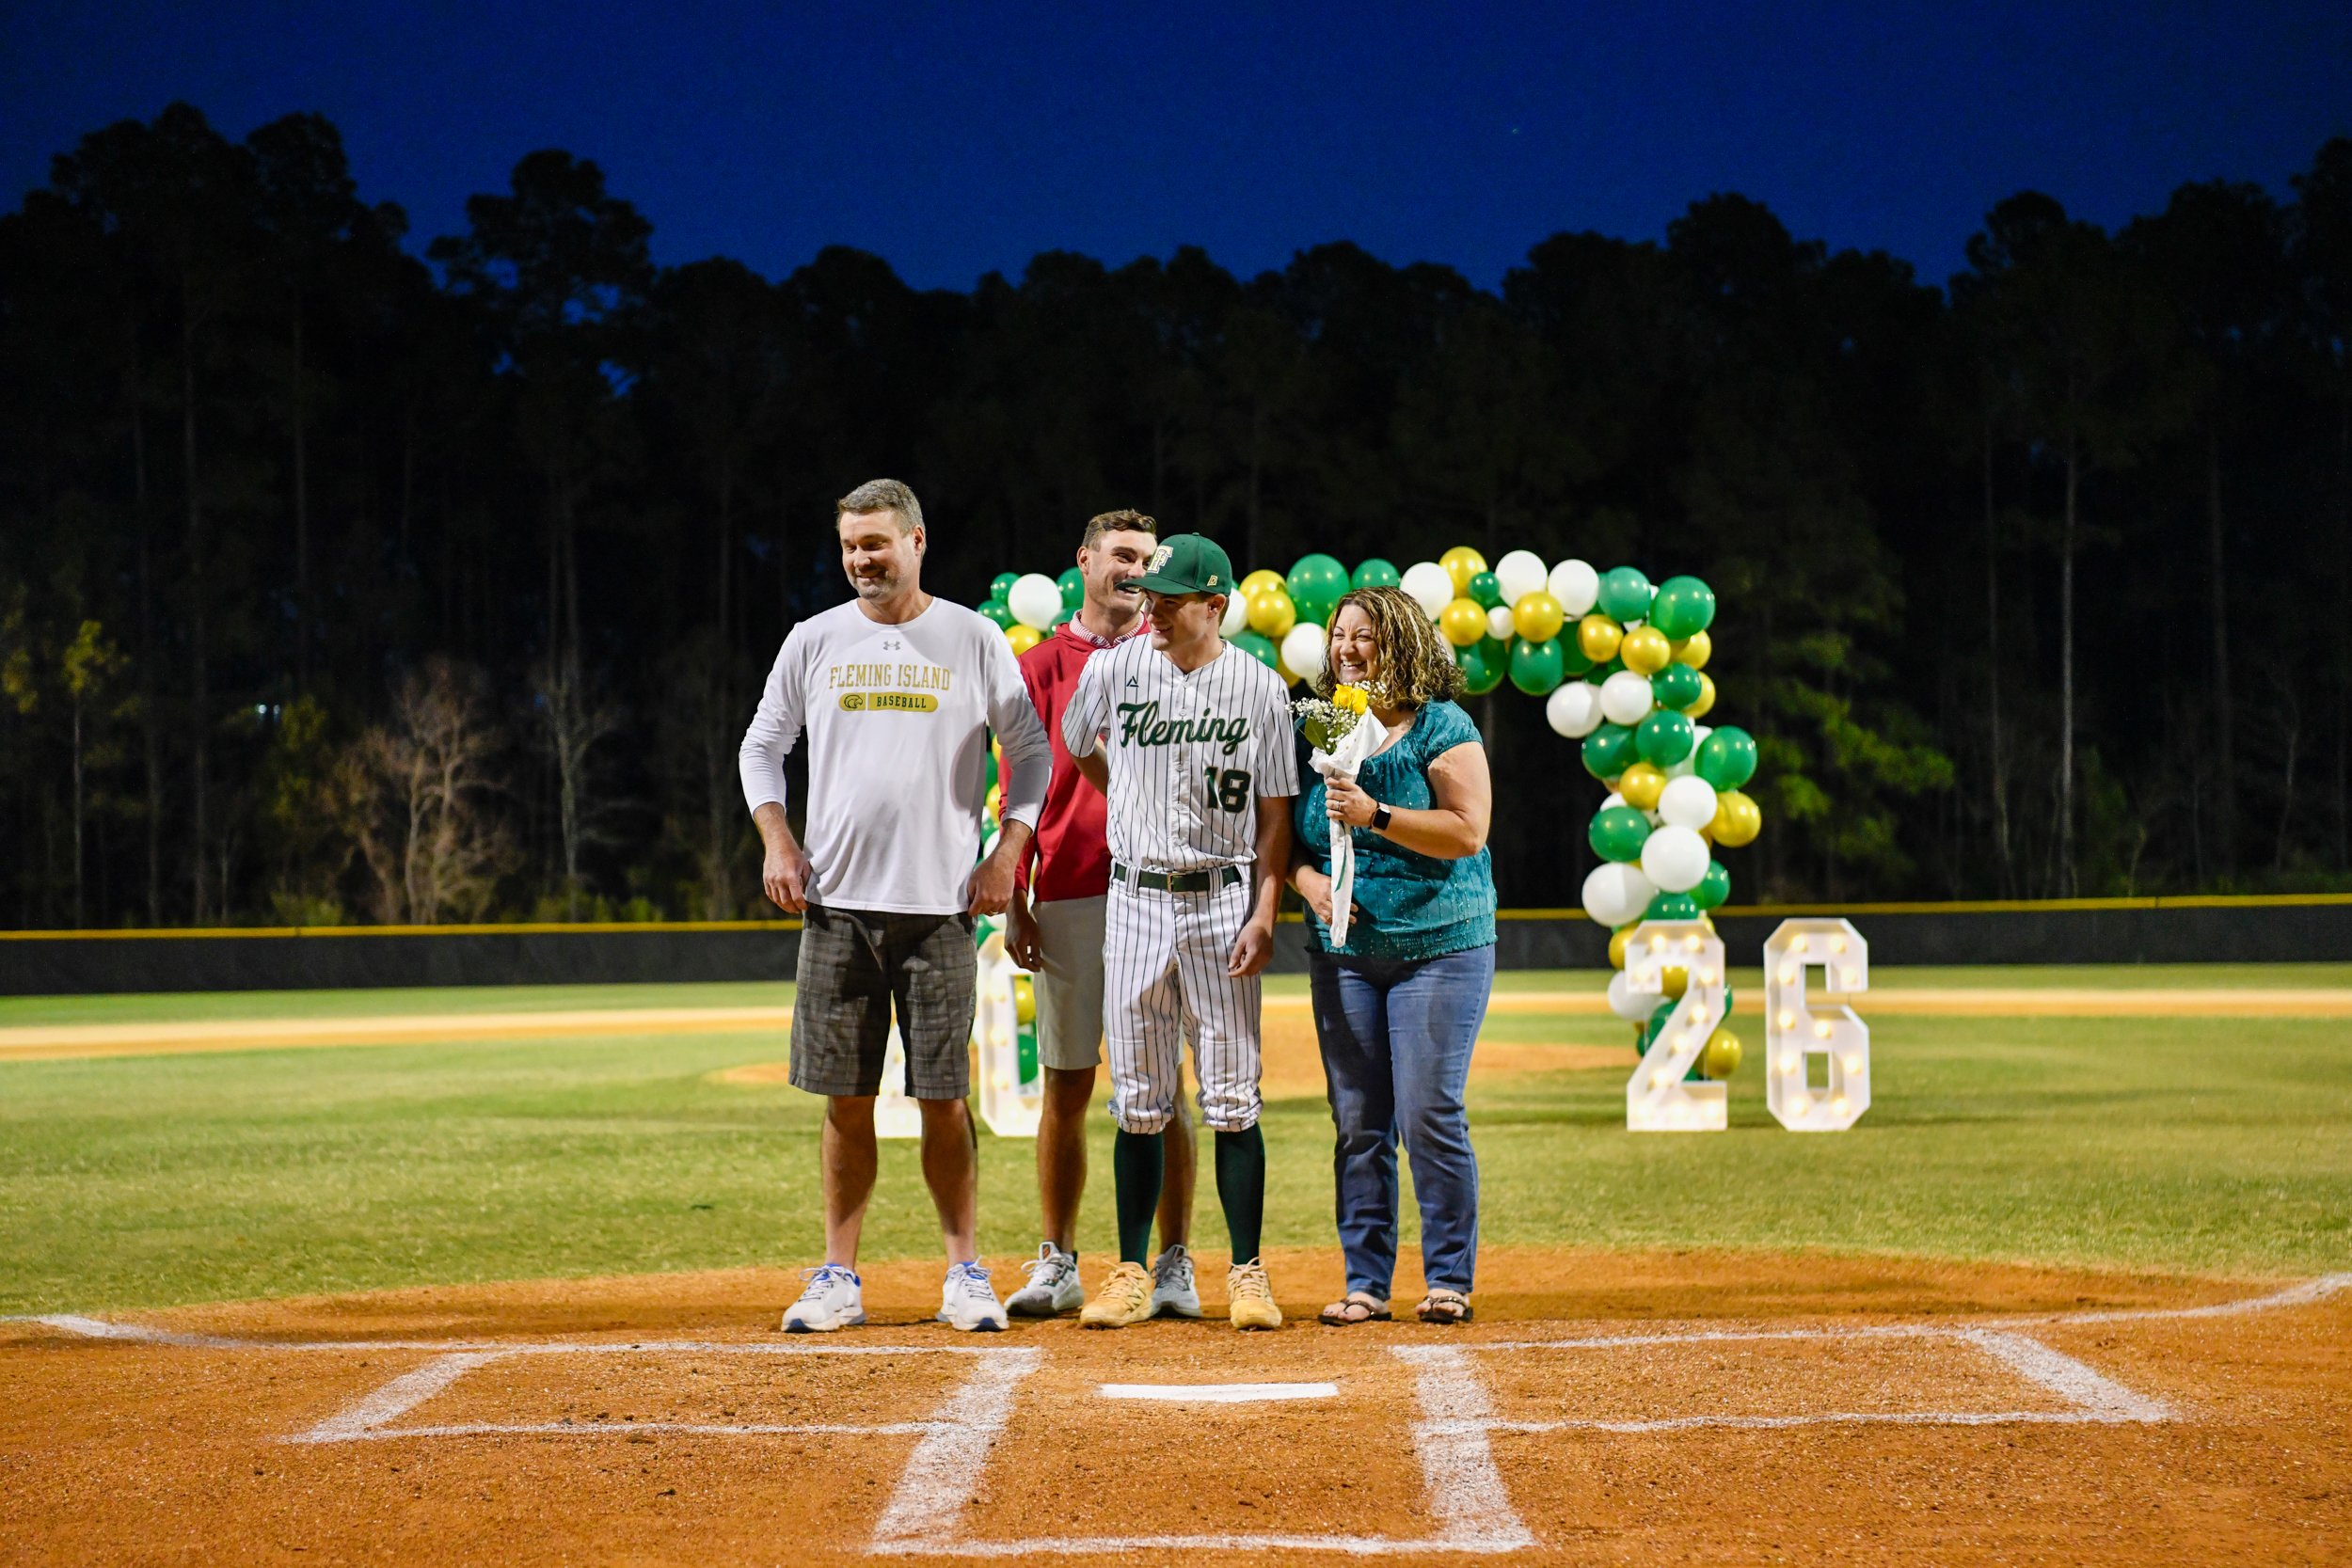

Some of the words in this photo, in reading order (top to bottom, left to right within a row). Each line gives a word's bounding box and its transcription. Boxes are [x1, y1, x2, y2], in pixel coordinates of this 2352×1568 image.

[829, 663, 892, 689] FLEMING
[897, 663, 951, 690] ISLAND
[877, 695, 927, 708] BASEBALL
[1117, 700, 1250, 755] Fleming
[1204, 766, 1252, 814] 18
[1625, 918, 1871, 1132] 26
